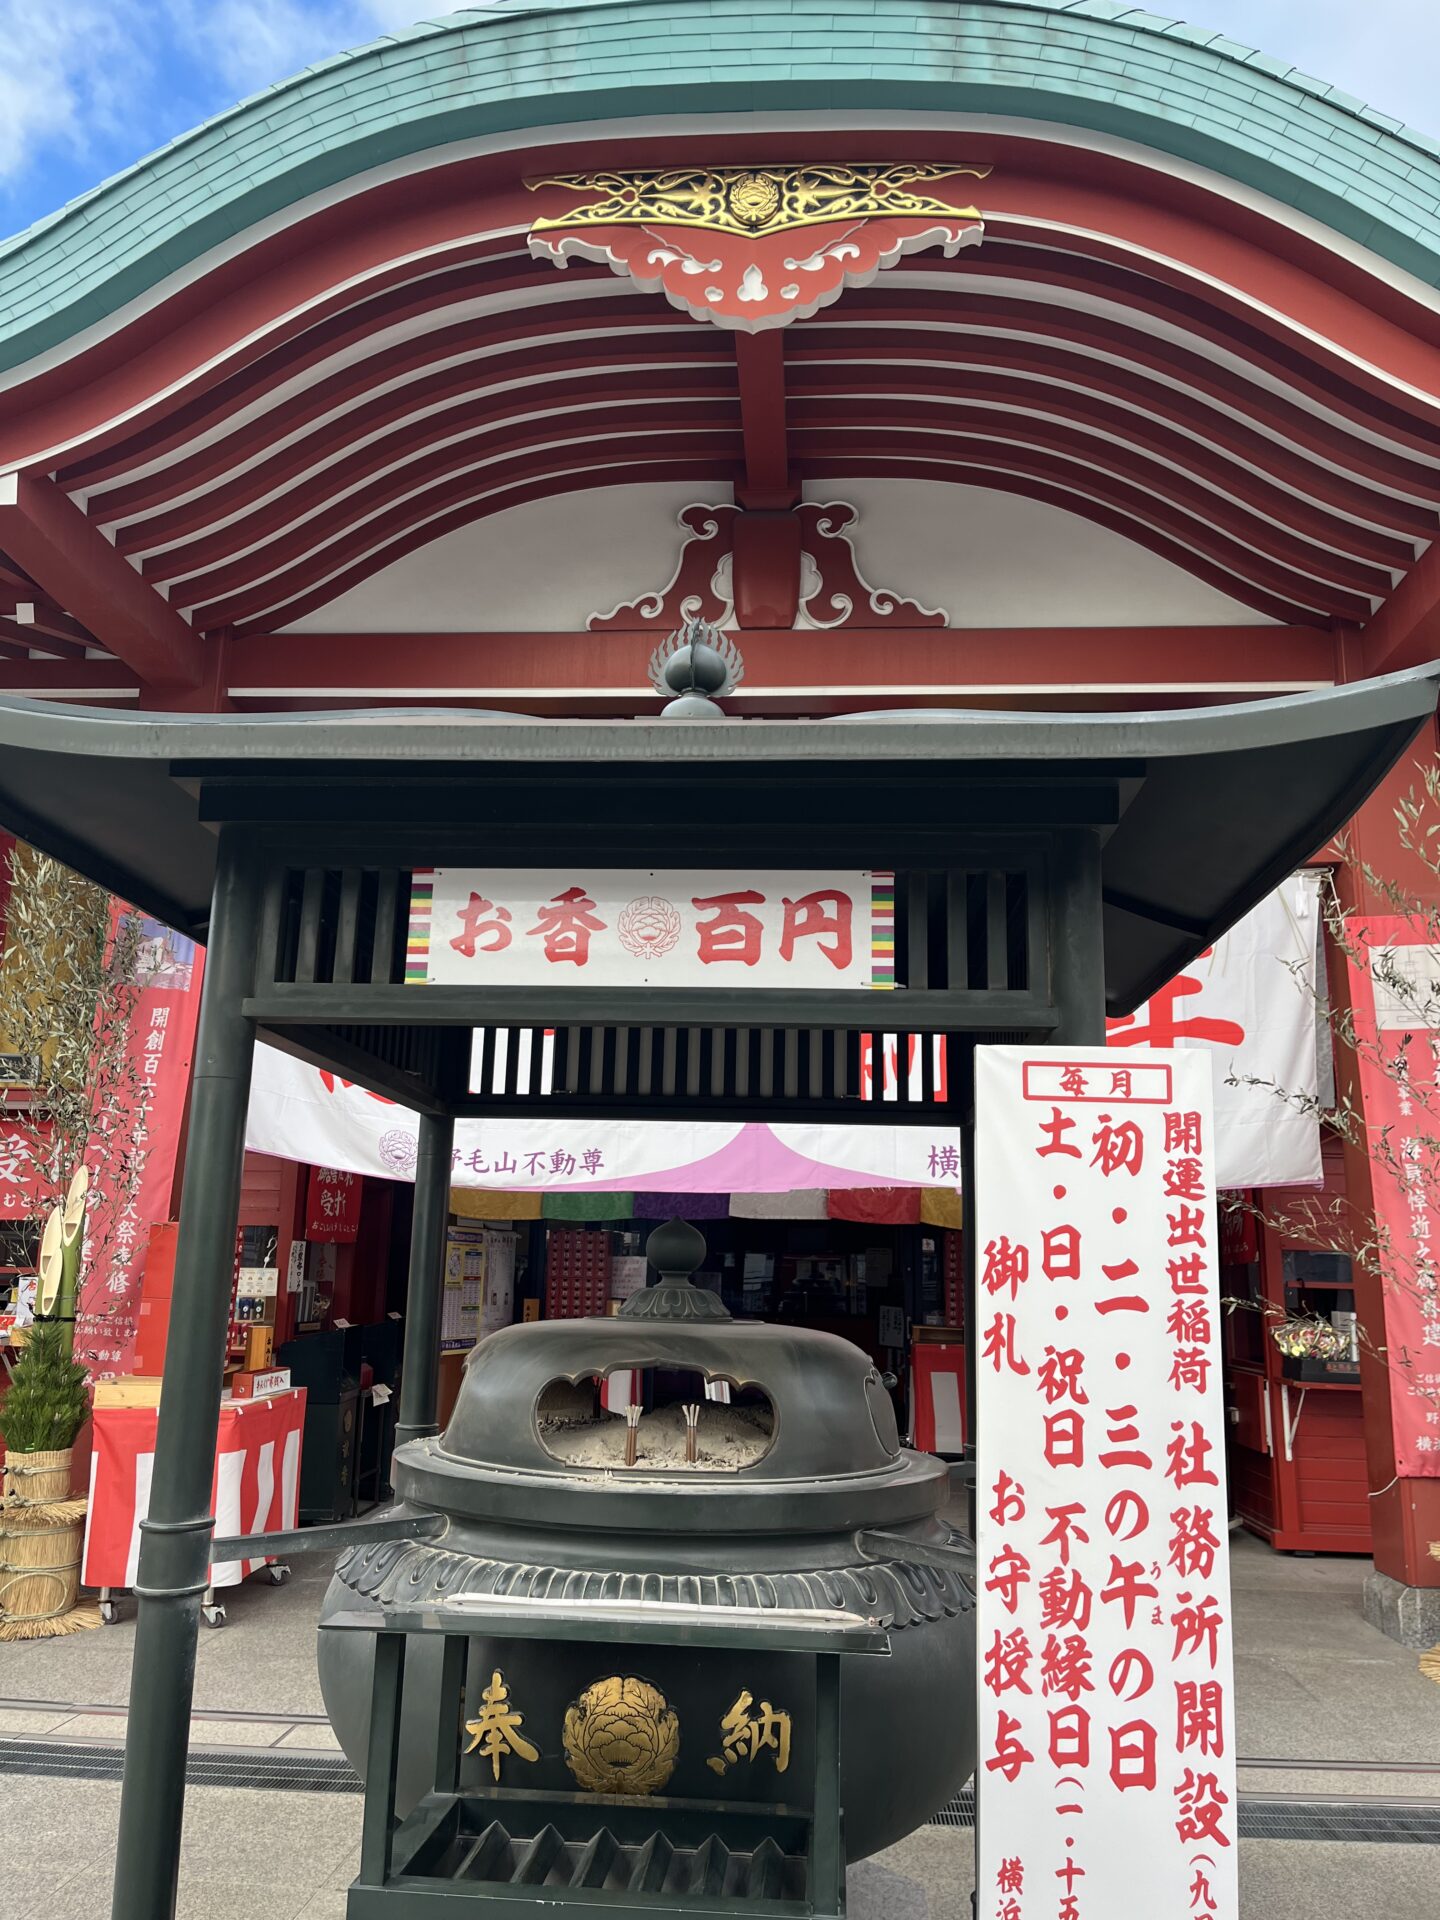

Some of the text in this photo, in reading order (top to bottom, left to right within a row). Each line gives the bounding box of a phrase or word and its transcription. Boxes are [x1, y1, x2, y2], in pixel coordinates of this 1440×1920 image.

[449, 887, 853, 970] お香 百円
[1059, 1067, 1132, 1098] 毎月
[927, 1145, 960, 1179] 横
[981, 1235, 1031, 1376] 御札
[1162, 1110, 1213, 1395] 開運出世稲荷
[984, 1470, 1034, 1783] お守授与
[1149, 1560, 1165, 1625] うま
[464, 1669, 793, 1782] 奉 納
[1164, 1420, 1231, 1920] 社務所開設(九
